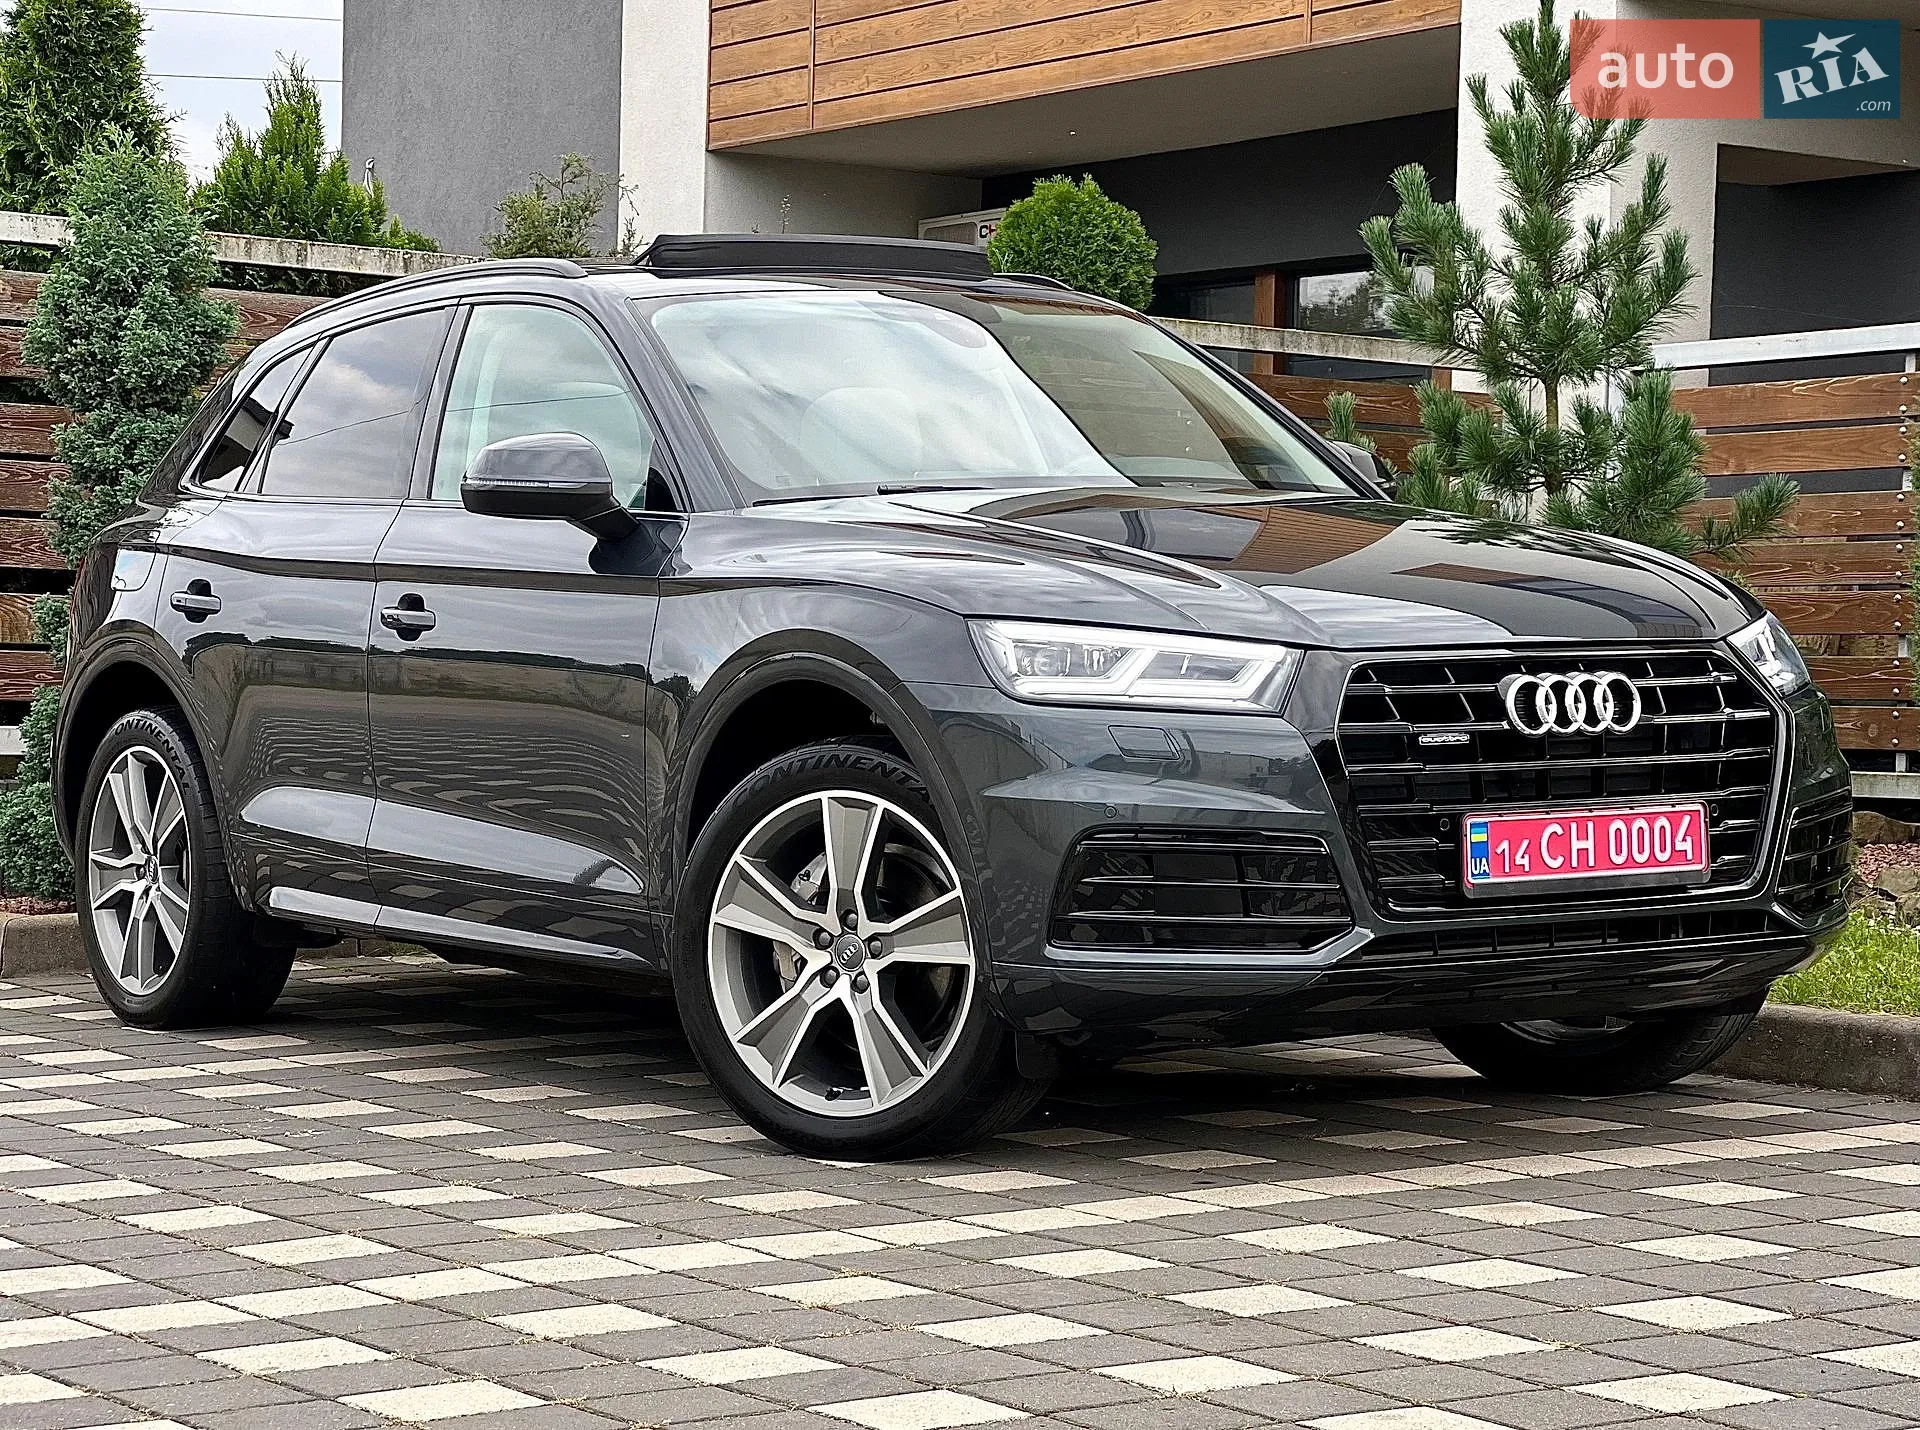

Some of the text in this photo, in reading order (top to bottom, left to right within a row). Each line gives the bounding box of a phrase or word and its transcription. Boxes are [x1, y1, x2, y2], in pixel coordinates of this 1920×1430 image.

[109, 717, 191, 796] ONTINENTAL
[732, 753, 934, 808] CONTINENTA
[1471, 857, 1490, 876] UA
[1495, 813, 1694, 875] 14 CH 0004
